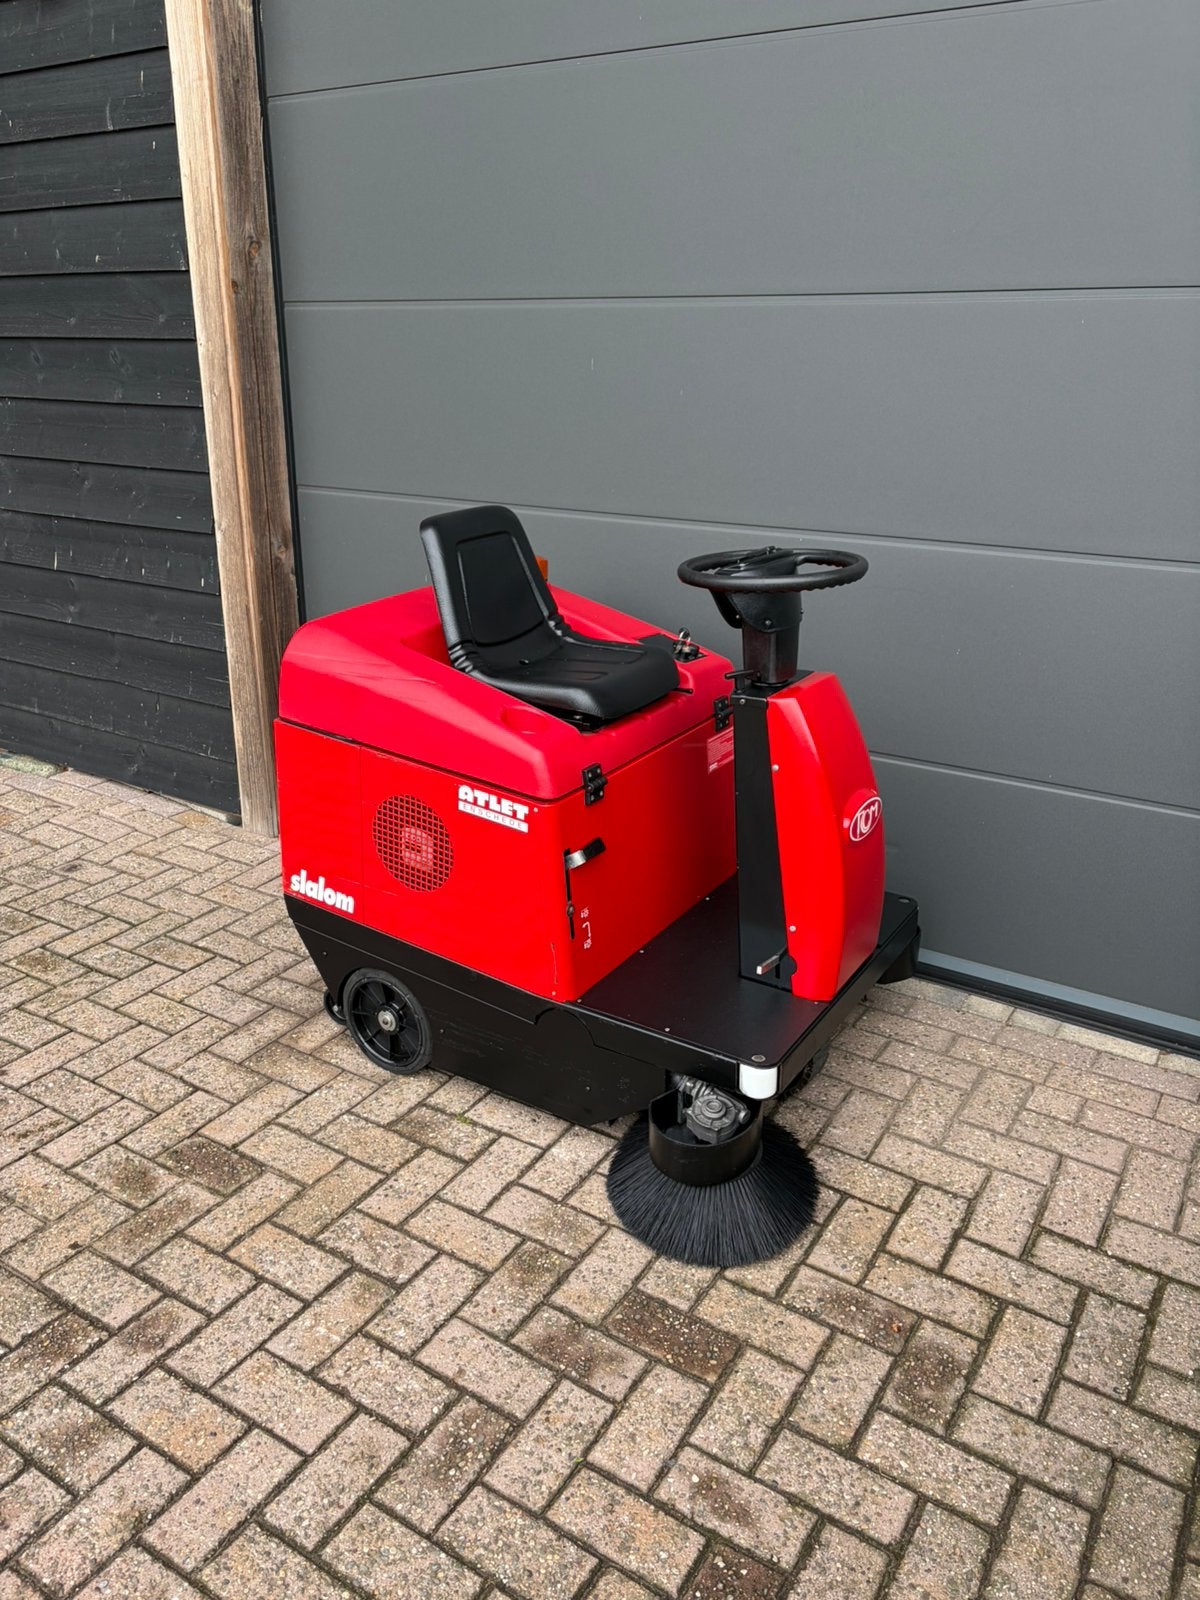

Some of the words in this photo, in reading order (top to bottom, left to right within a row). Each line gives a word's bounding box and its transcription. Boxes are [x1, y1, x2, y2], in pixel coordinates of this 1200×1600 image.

[458, 784, 529, 820] ATLET
[462, 803, 523, 829] ENSCHEDE
[290, 868, 355, 914] slalom
